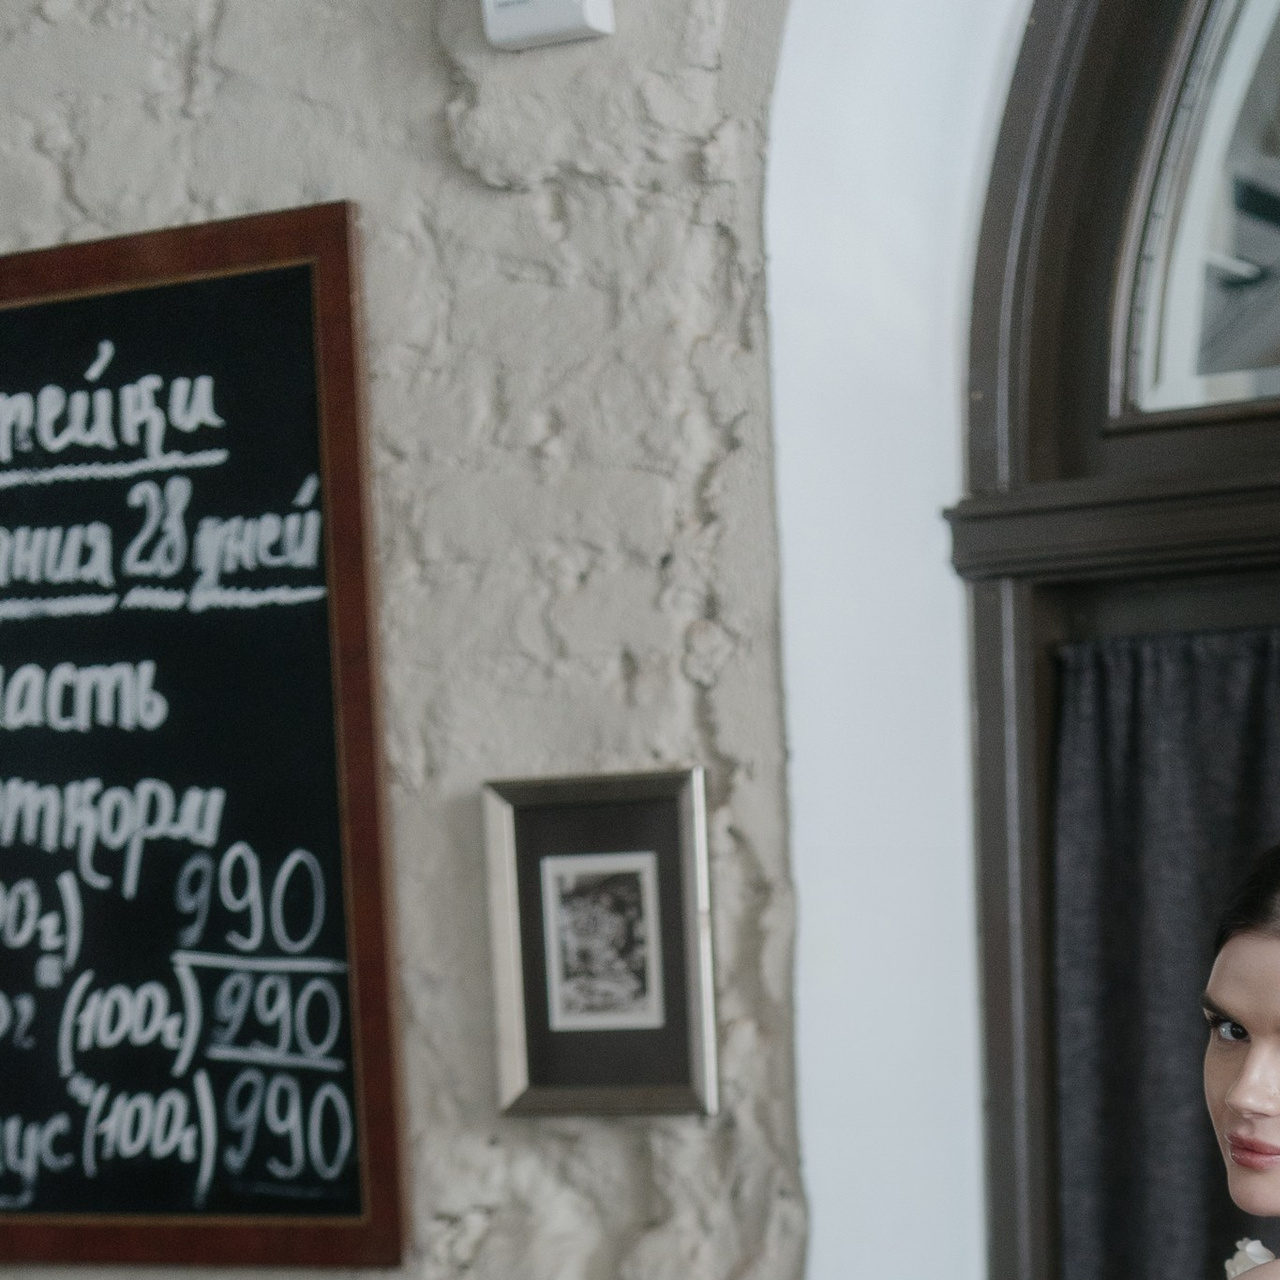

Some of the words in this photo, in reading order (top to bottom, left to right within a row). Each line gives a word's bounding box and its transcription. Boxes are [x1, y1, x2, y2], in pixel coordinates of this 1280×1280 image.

[121, 474, 193, 578] 28
[193, 474, 320, 598] дней
[0, 659, 169, 733] асть
[175, 842, 327, 953] 990
[211, 972, 342, 1060] 990
[223, 1068, 354, 1181] 990
